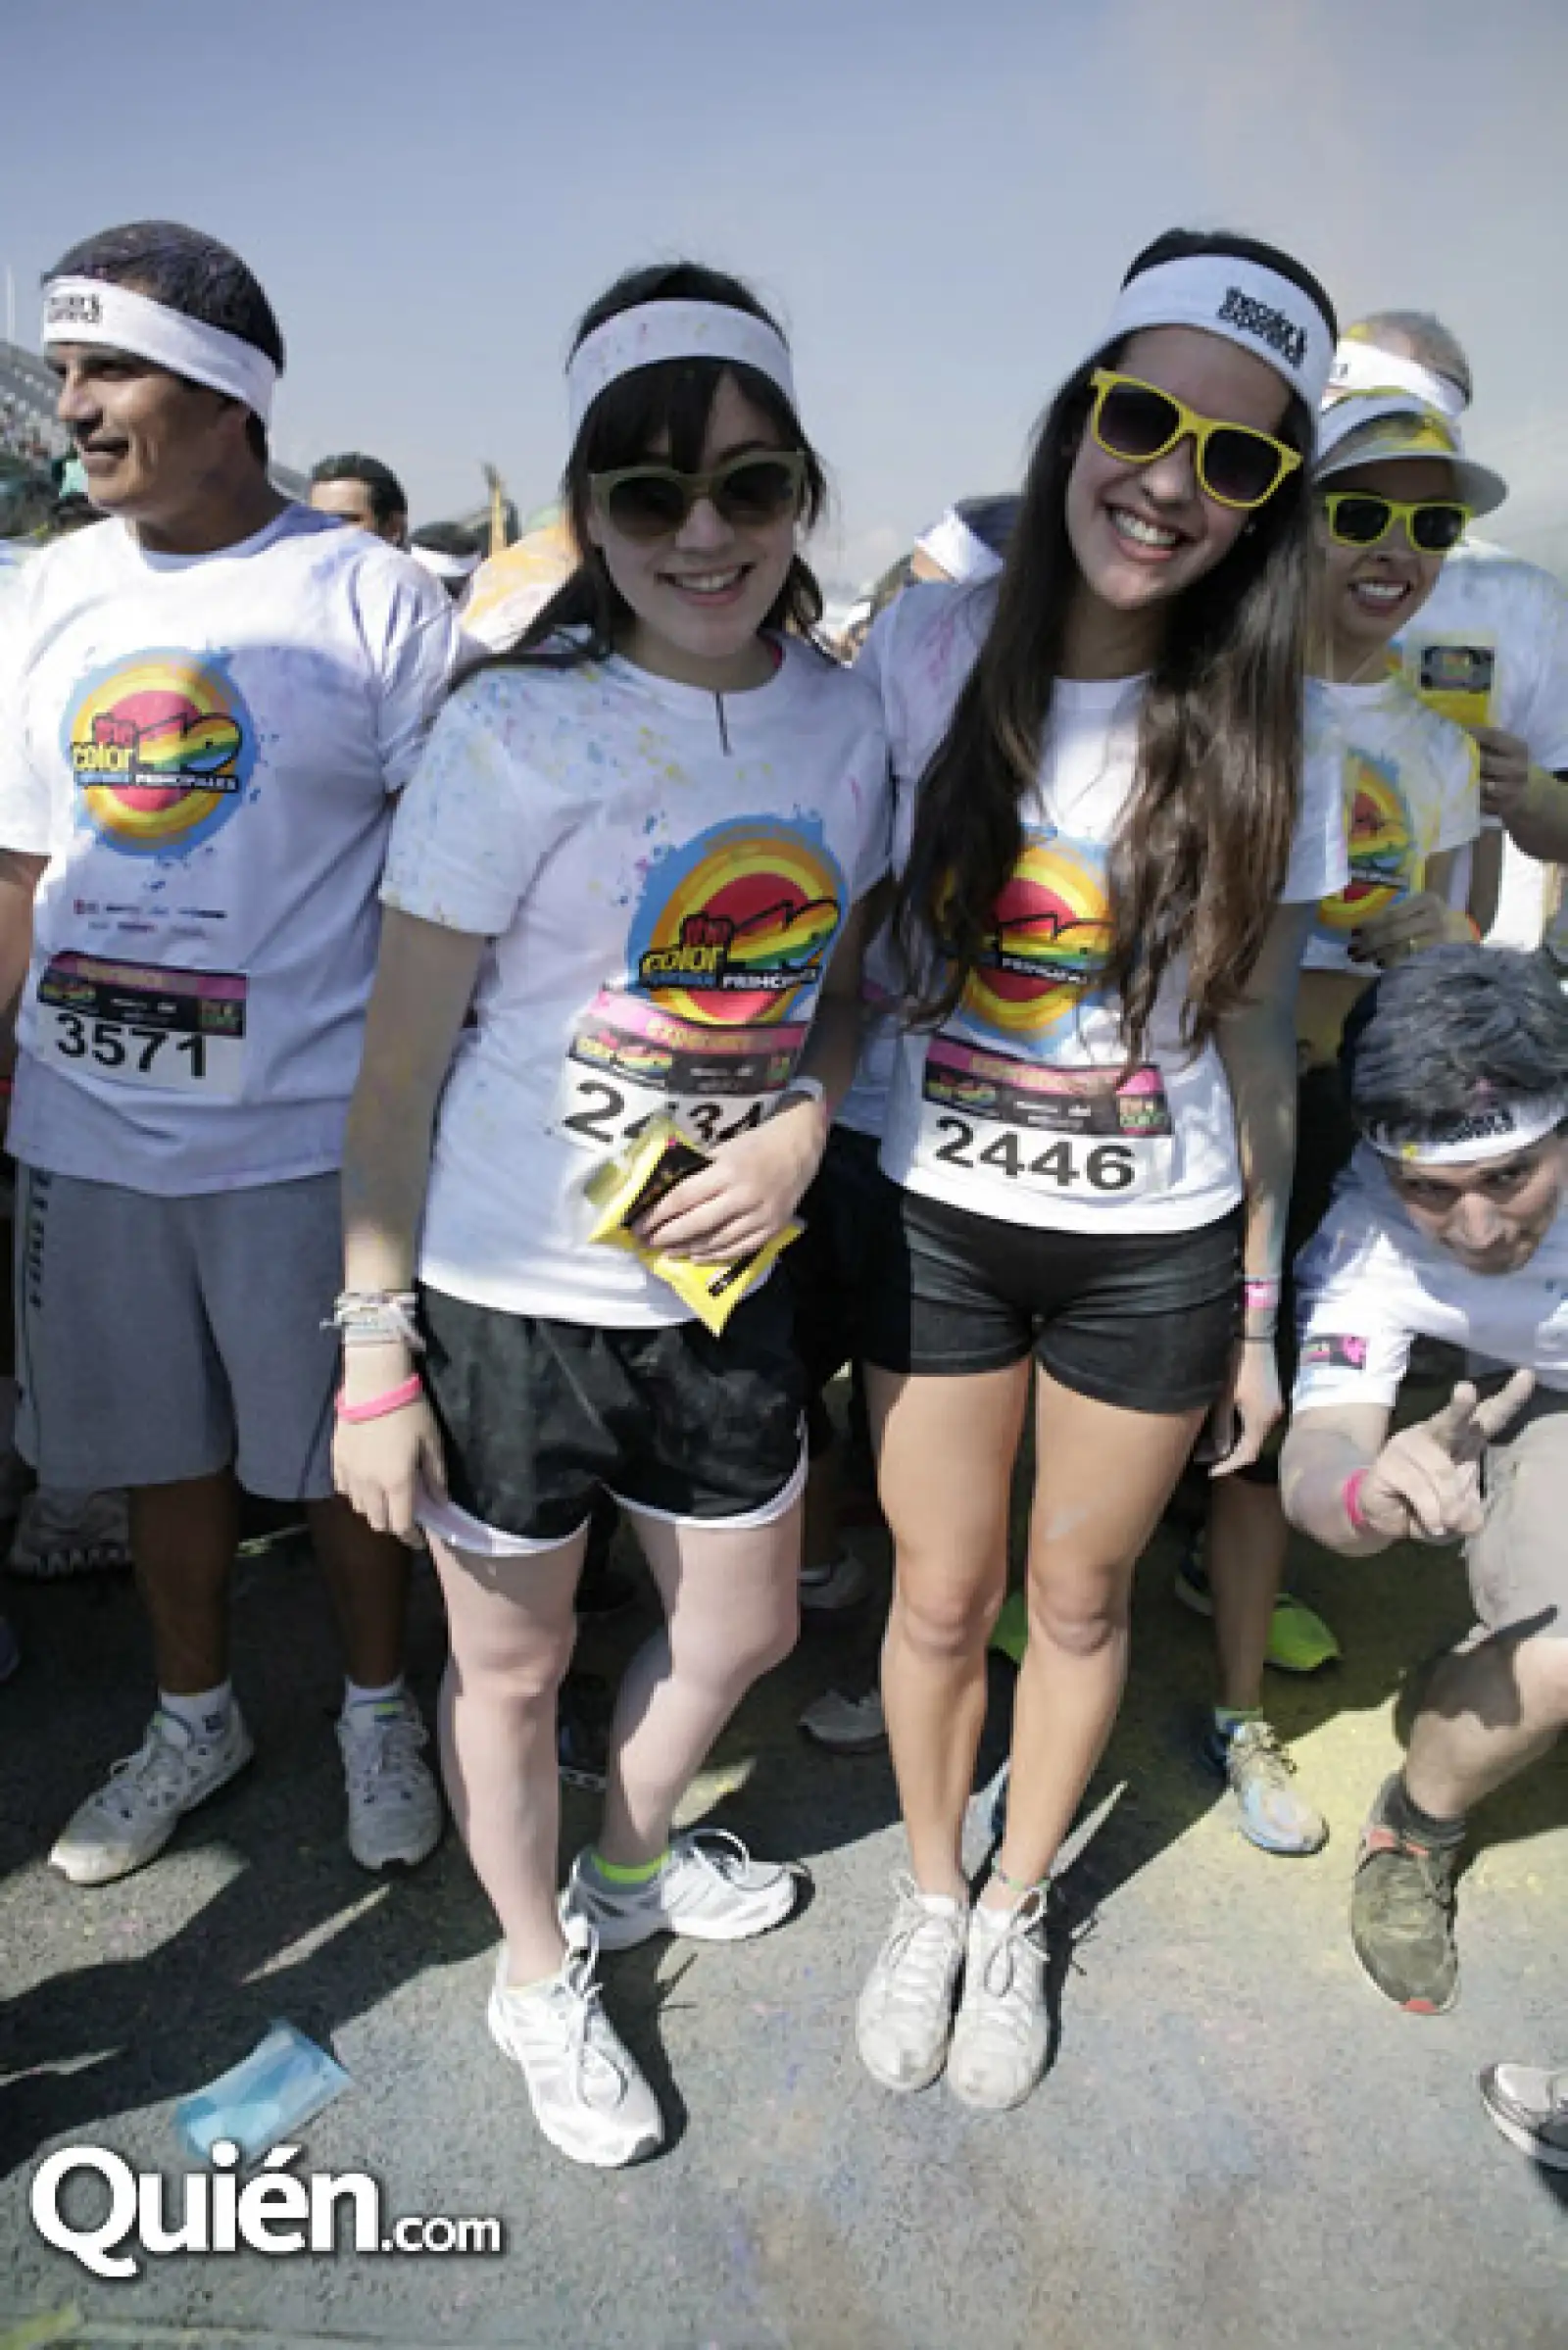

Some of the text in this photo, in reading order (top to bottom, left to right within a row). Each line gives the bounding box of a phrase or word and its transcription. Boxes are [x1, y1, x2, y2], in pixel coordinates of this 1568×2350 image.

[642, 946, 723, 975] color
[55, 1012, 207, 1079] 3571
[935, 1115, 1136, 1190] 2446
